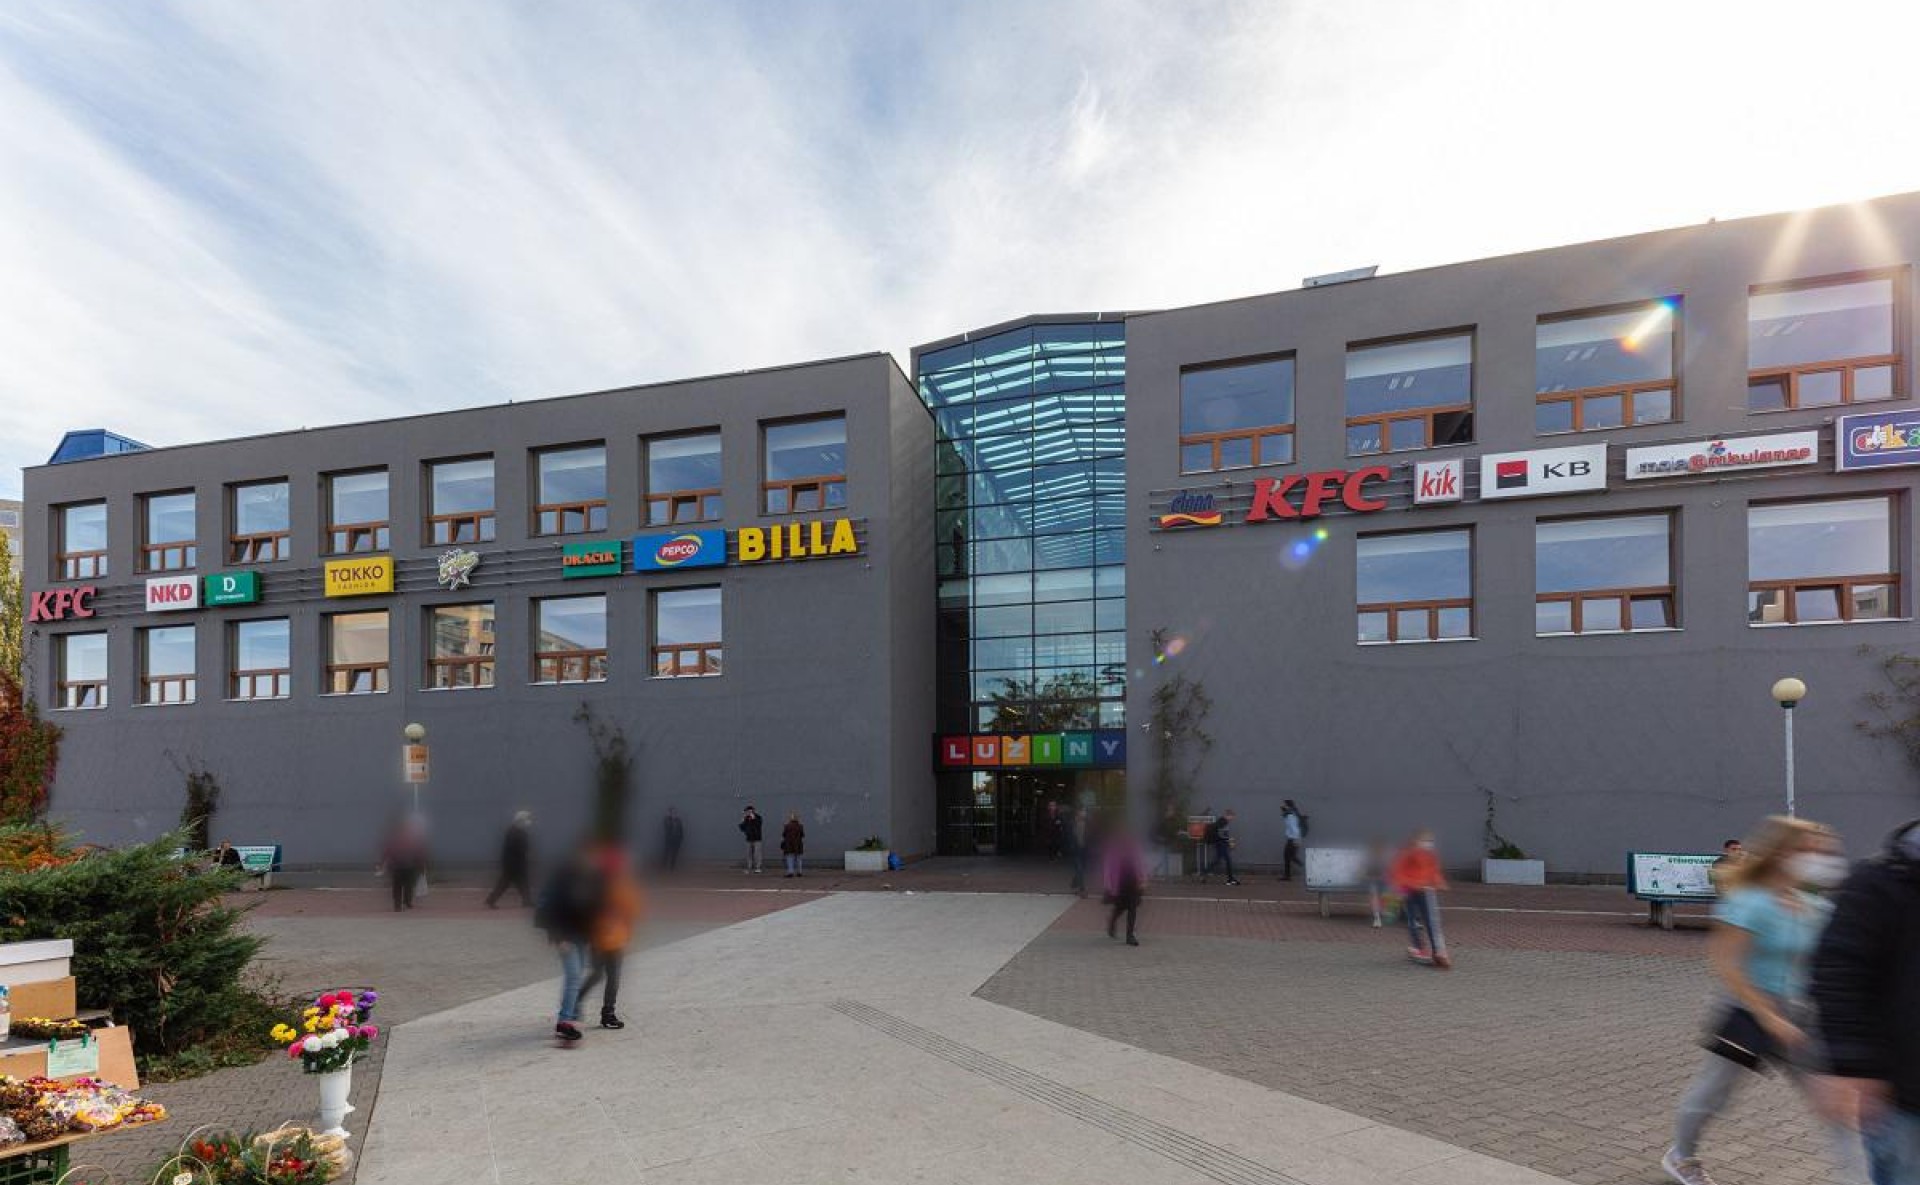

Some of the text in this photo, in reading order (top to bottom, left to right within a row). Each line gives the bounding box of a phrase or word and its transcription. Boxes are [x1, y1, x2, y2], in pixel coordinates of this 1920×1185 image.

[1421, 466, 1457, 498] kik
[1543, 460, 1590, 480] KB
[1245, 466, 1391, 522] KFC
[661, 545, 695, 556] PEPCO
[739, 518, 857, 561] BILLA
[150, 583, 193, 603] NKD
[223, 577, 236, 592] D
[28, 585, 96, 621] KFC
